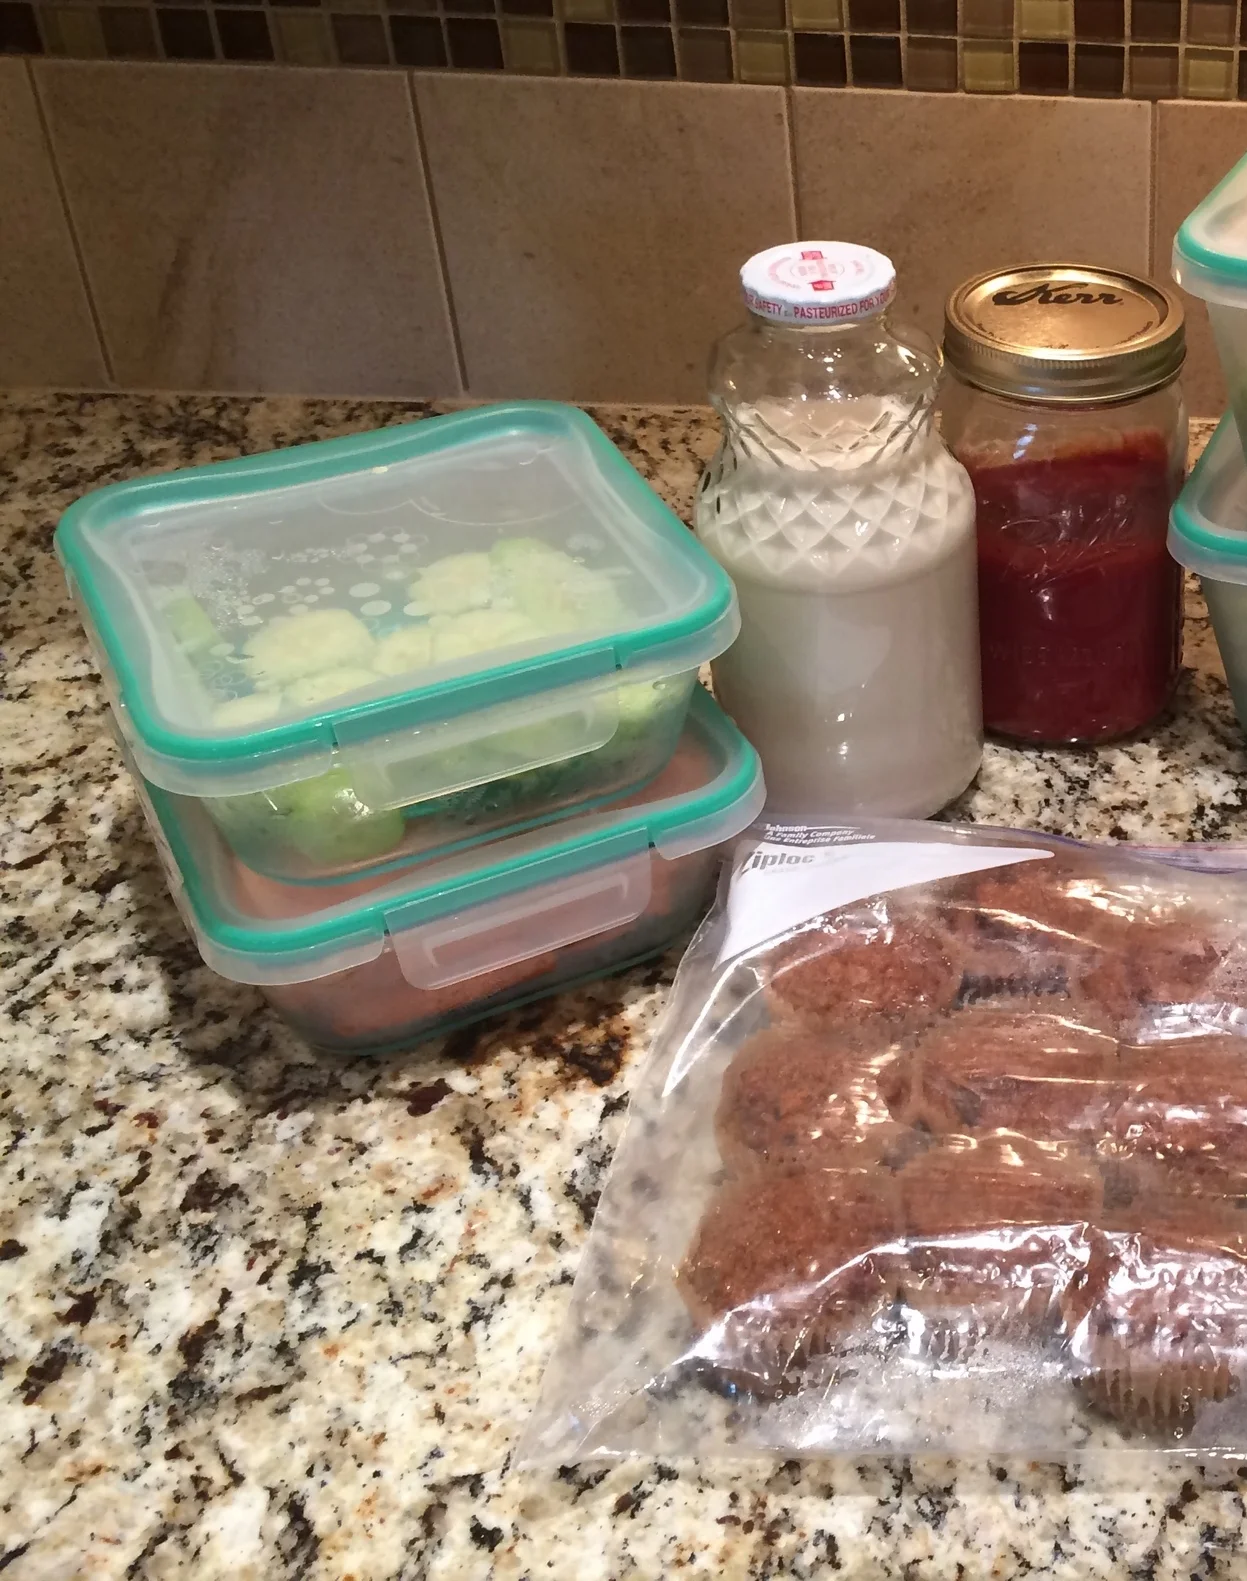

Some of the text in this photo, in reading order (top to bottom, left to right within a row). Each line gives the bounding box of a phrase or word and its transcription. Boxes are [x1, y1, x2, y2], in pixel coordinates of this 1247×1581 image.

[992, 283, 1124, 306] Kerr
[755, 300, 782, 316] SAFETY
[793, 303, 858, 319] PASTEURIZED
[859, 297, 875, 314] FOR
[775, 831, 809, 839] Family
[810, 829, 855, 838] Company
[783, 837, 831, 845] Entreprise
